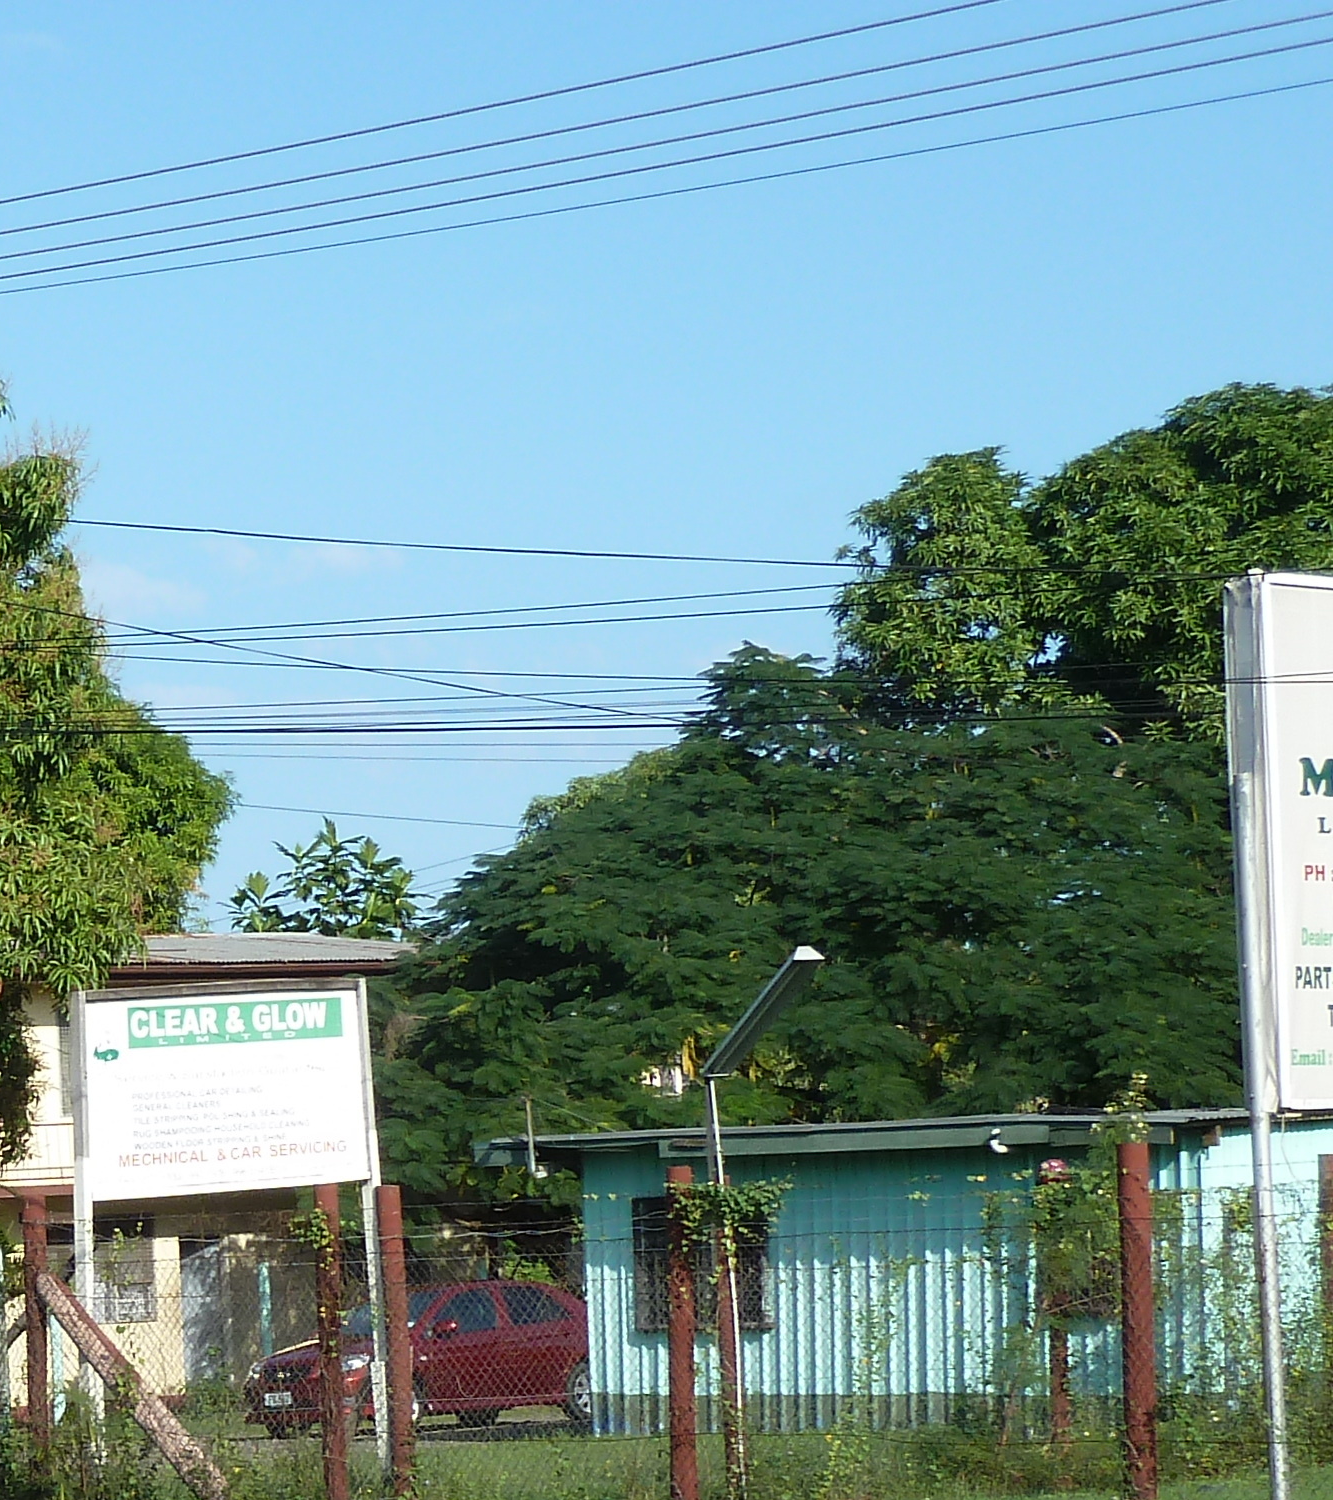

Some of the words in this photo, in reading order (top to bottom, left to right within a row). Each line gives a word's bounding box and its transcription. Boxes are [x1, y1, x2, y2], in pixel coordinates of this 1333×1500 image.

[1304, 865, 1325, 881] PH
[130, 1007, 219, 1038] CLEAR
[225, 1005, 245, 1034] &
[251, 1001, 327, 1032] GLOW
[159, 1030, 296, 1045] LIMITED
[1291, 1049, 1326, 1066] Email
[133, 1102, 173, 1113] GENERAL
[203, 1110, 249, 1121] POLSHING
[133, 1129, 152, 1139] RUG
[118, 1149, 209, 1168] MECHNICAL
[216, 1147, 227, 1162] &
[230, 1145, 262, 1161] CAR
[269, 1139, 347, 1158] SERVICING
